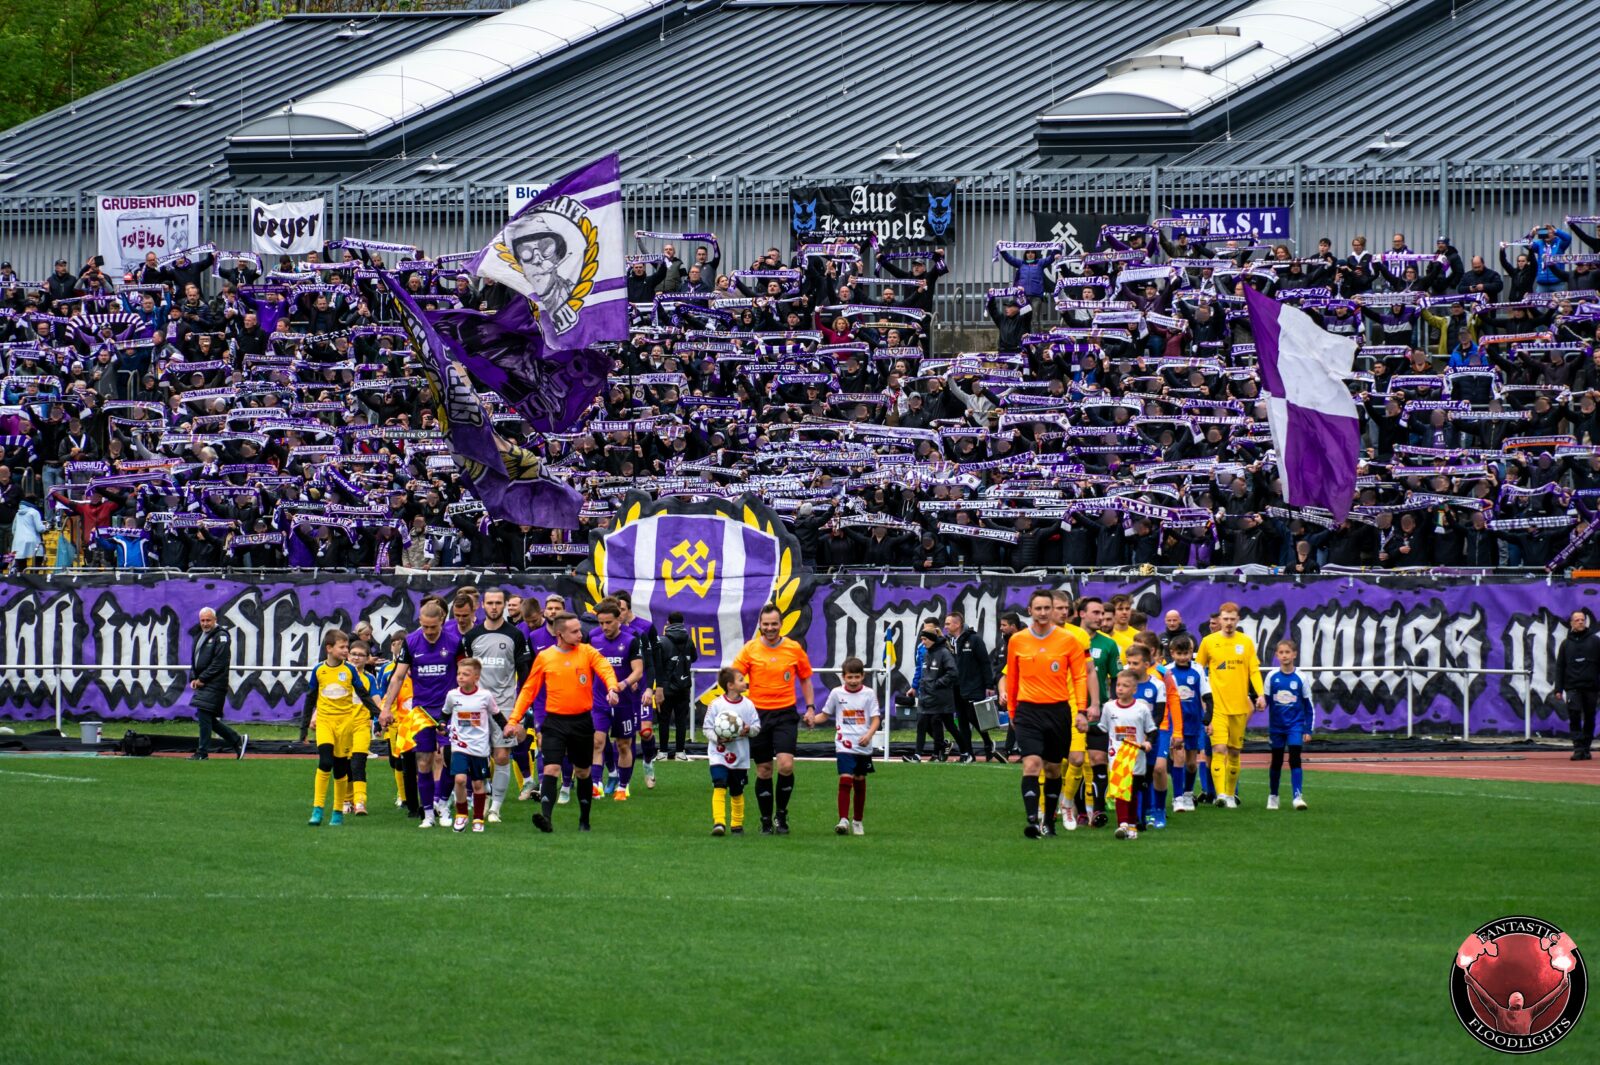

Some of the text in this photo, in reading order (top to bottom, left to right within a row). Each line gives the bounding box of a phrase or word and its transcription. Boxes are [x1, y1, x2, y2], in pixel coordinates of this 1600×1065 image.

[516, 187, 545, 199] Blo
[850, 184, 897, 215] Aue
[102, 194, 197, 211] GRUBENHUND
[253, 206, 319, 250] Geyer
[1181, 212, 1282, 235] WK.S.T.
[1064, 277, 1093, 285] WISMUT
[74, 461, 103, 471] WISMUT
[1128, 500, 1169, 518] LTRAS
[479, 656, 505, 665] MBR
[417, 664, 447, 673] MBR
[622, 719, 632, 732] 10
